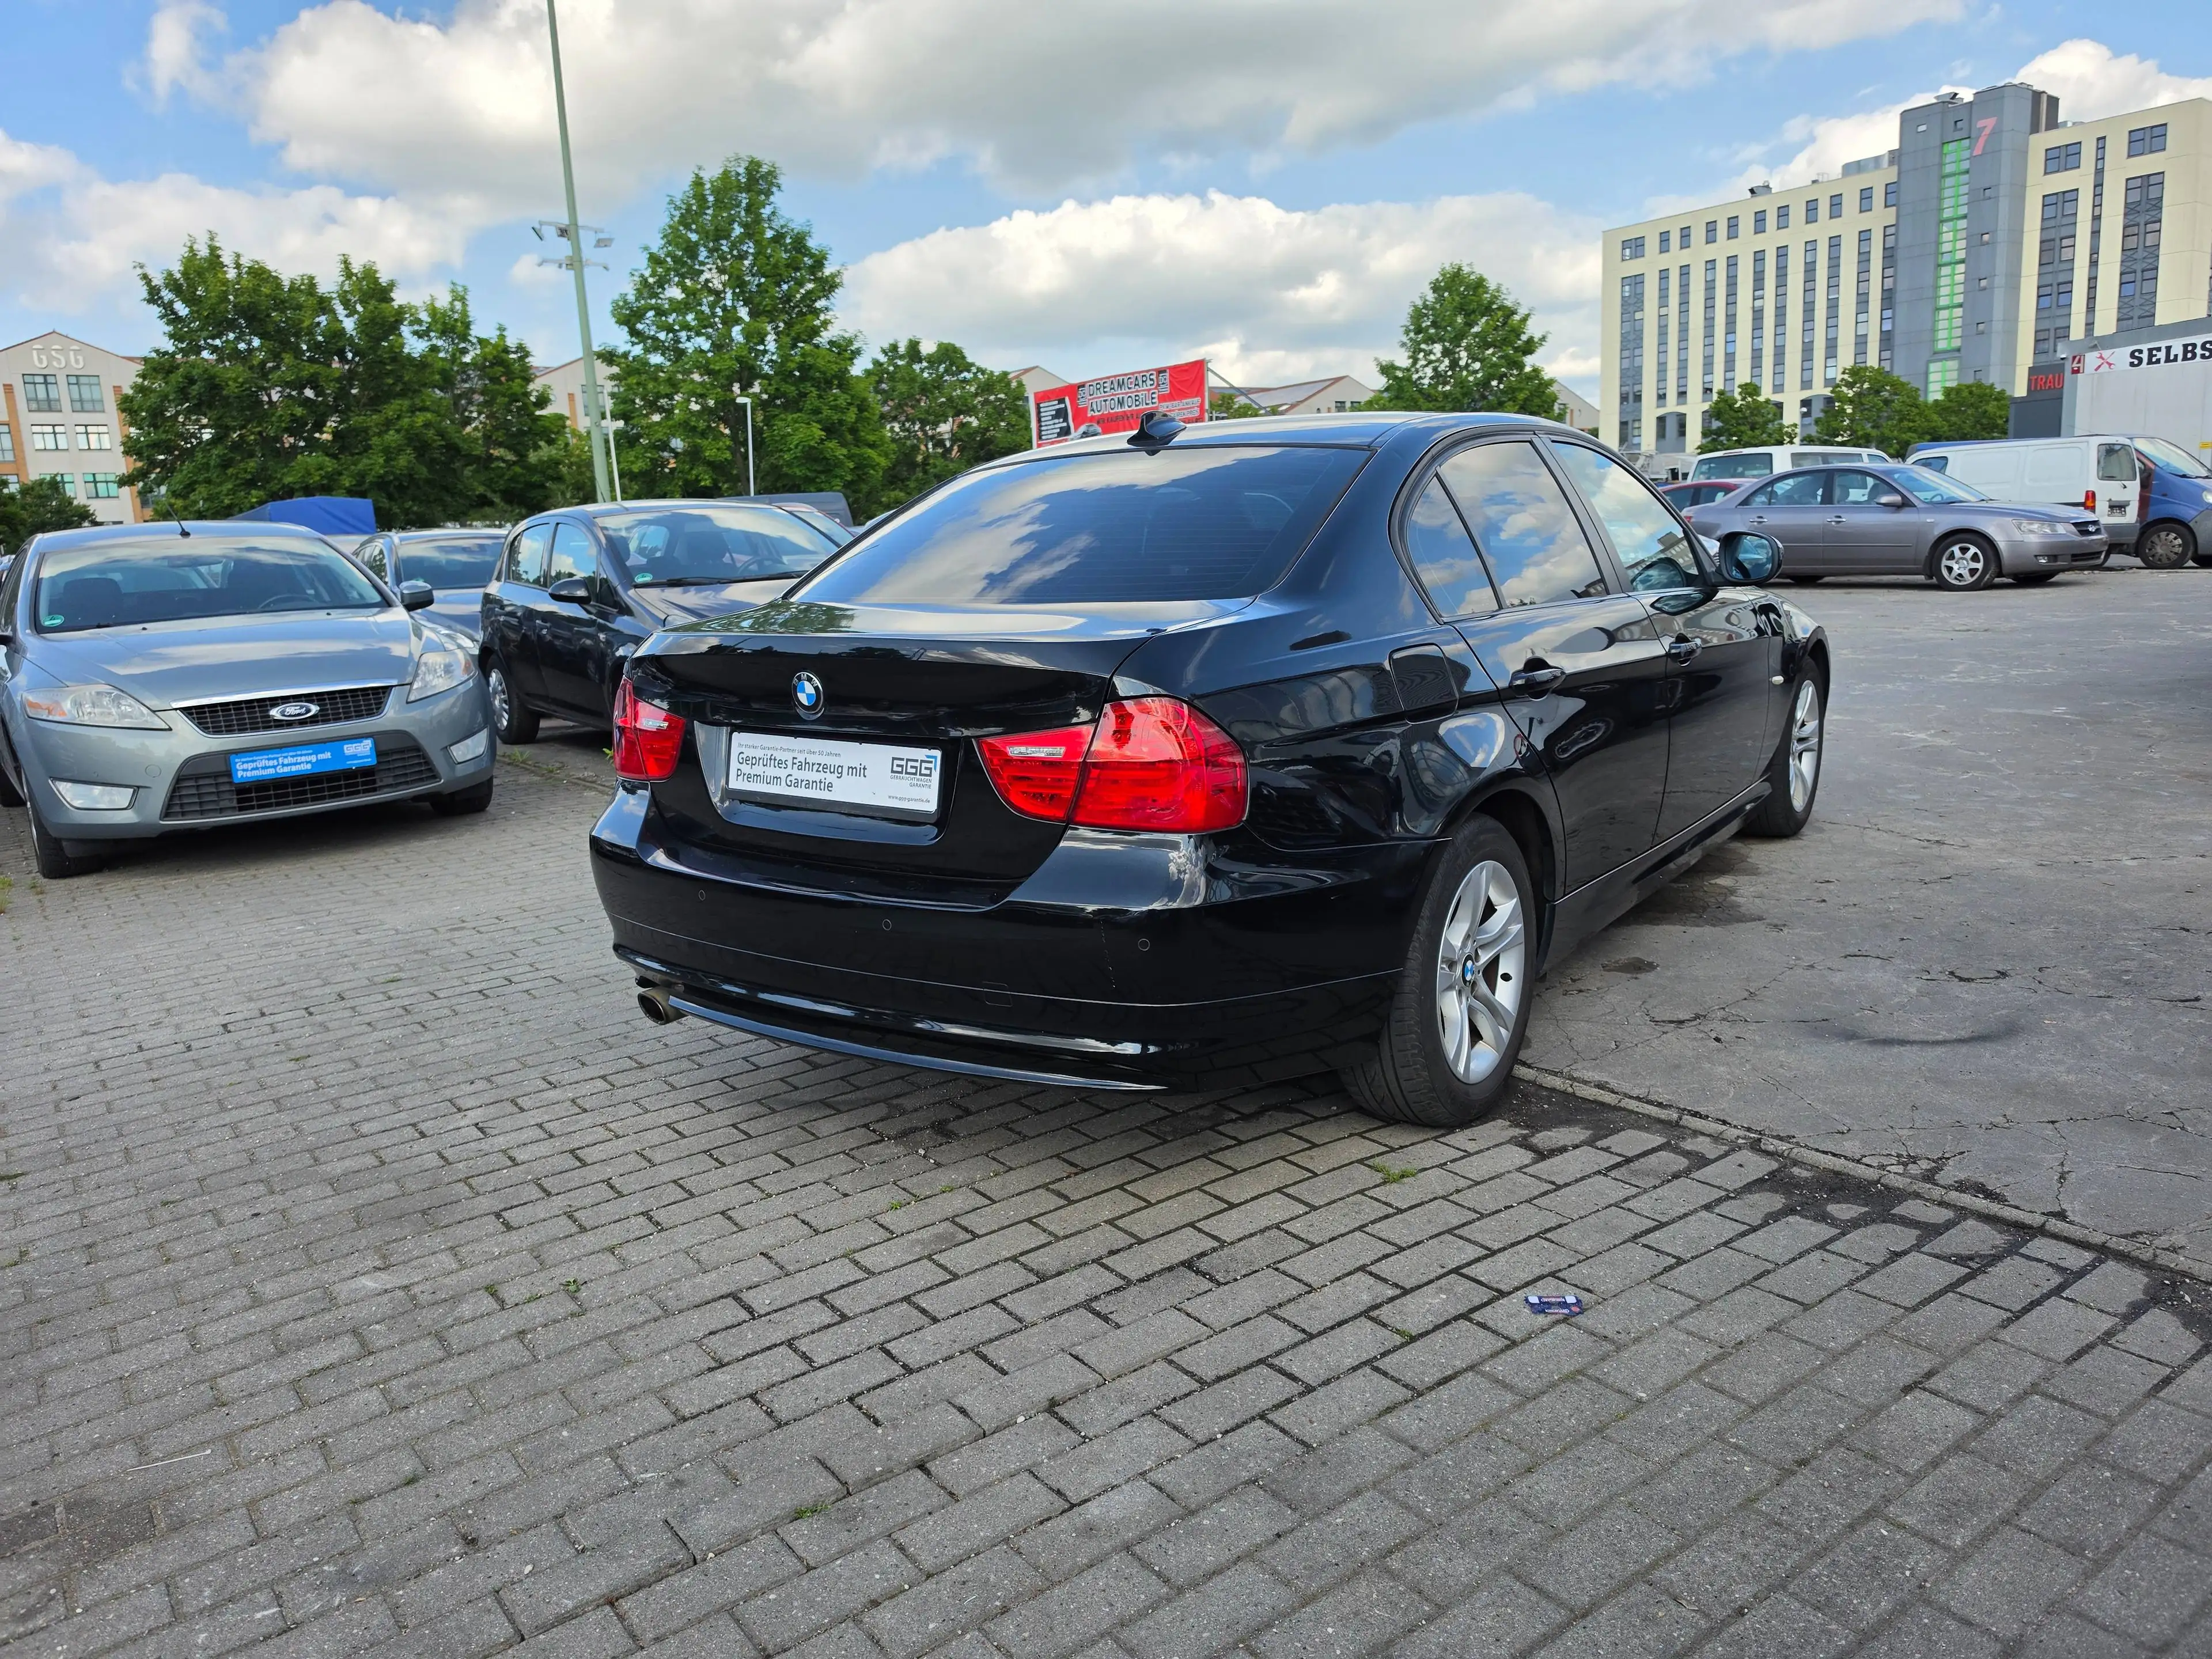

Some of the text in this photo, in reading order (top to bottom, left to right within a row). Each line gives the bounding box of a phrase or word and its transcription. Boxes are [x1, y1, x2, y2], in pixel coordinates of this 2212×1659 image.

[1972, 116, 1998, 157] 7
[32, 344, 84, 369] GSG
[2129, 340, 2212, 368] SELBS
[1088, 373, 1156, 396] DREAMCARS
[793, 673, 818, 687] BMW
[285, 706, 306, 715] Ford
[760, 744, 797, 753] Garantie-Partner
[236, 757, 278, 771] Geprüftes
[279, 753, 316, 764] Fahrzeug
[317, 752, 332, 760] mit
[237, 762, 312, 778] Premium Garantie
[737, 751, 868, 779] Geprüftes Fahrzeug mit
[891, 756, 933, 778] GGG
[736, 768, 834, 792] Premium Garantie
[890, 775, 932, 783] GEBRAUCHTWAGEN
